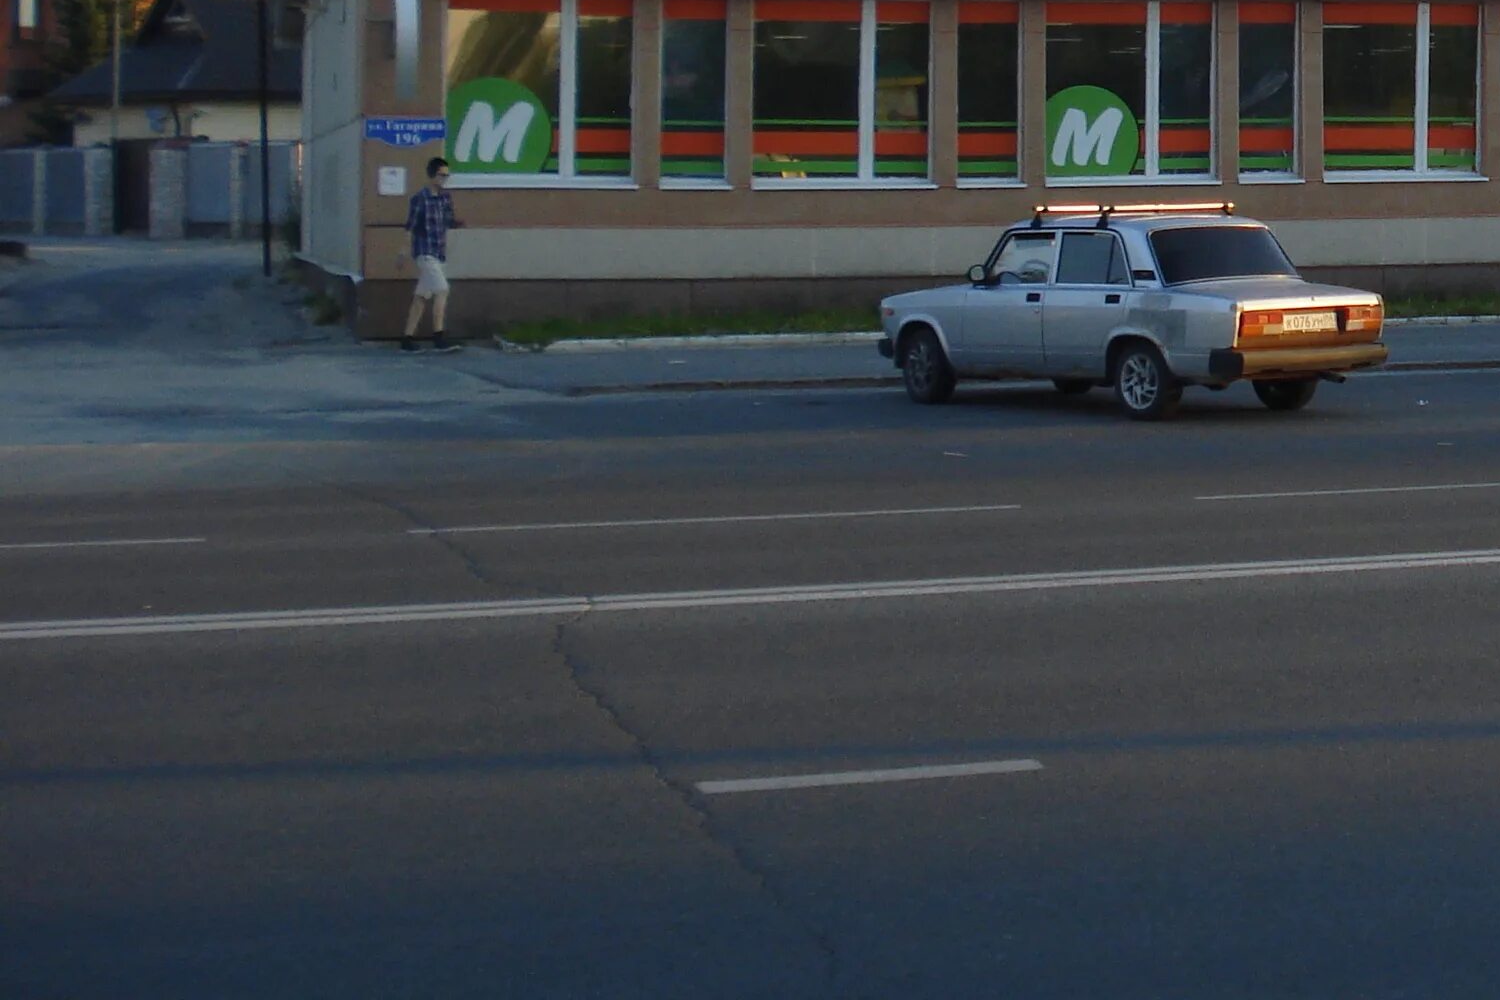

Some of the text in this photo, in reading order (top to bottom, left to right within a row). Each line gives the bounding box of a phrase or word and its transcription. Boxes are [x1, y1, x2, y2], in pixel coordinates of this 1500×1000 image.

[396, 133, 421, 144] 196
[454, 100, 534, 163] М
[1052, 107, 1123, 166] М
